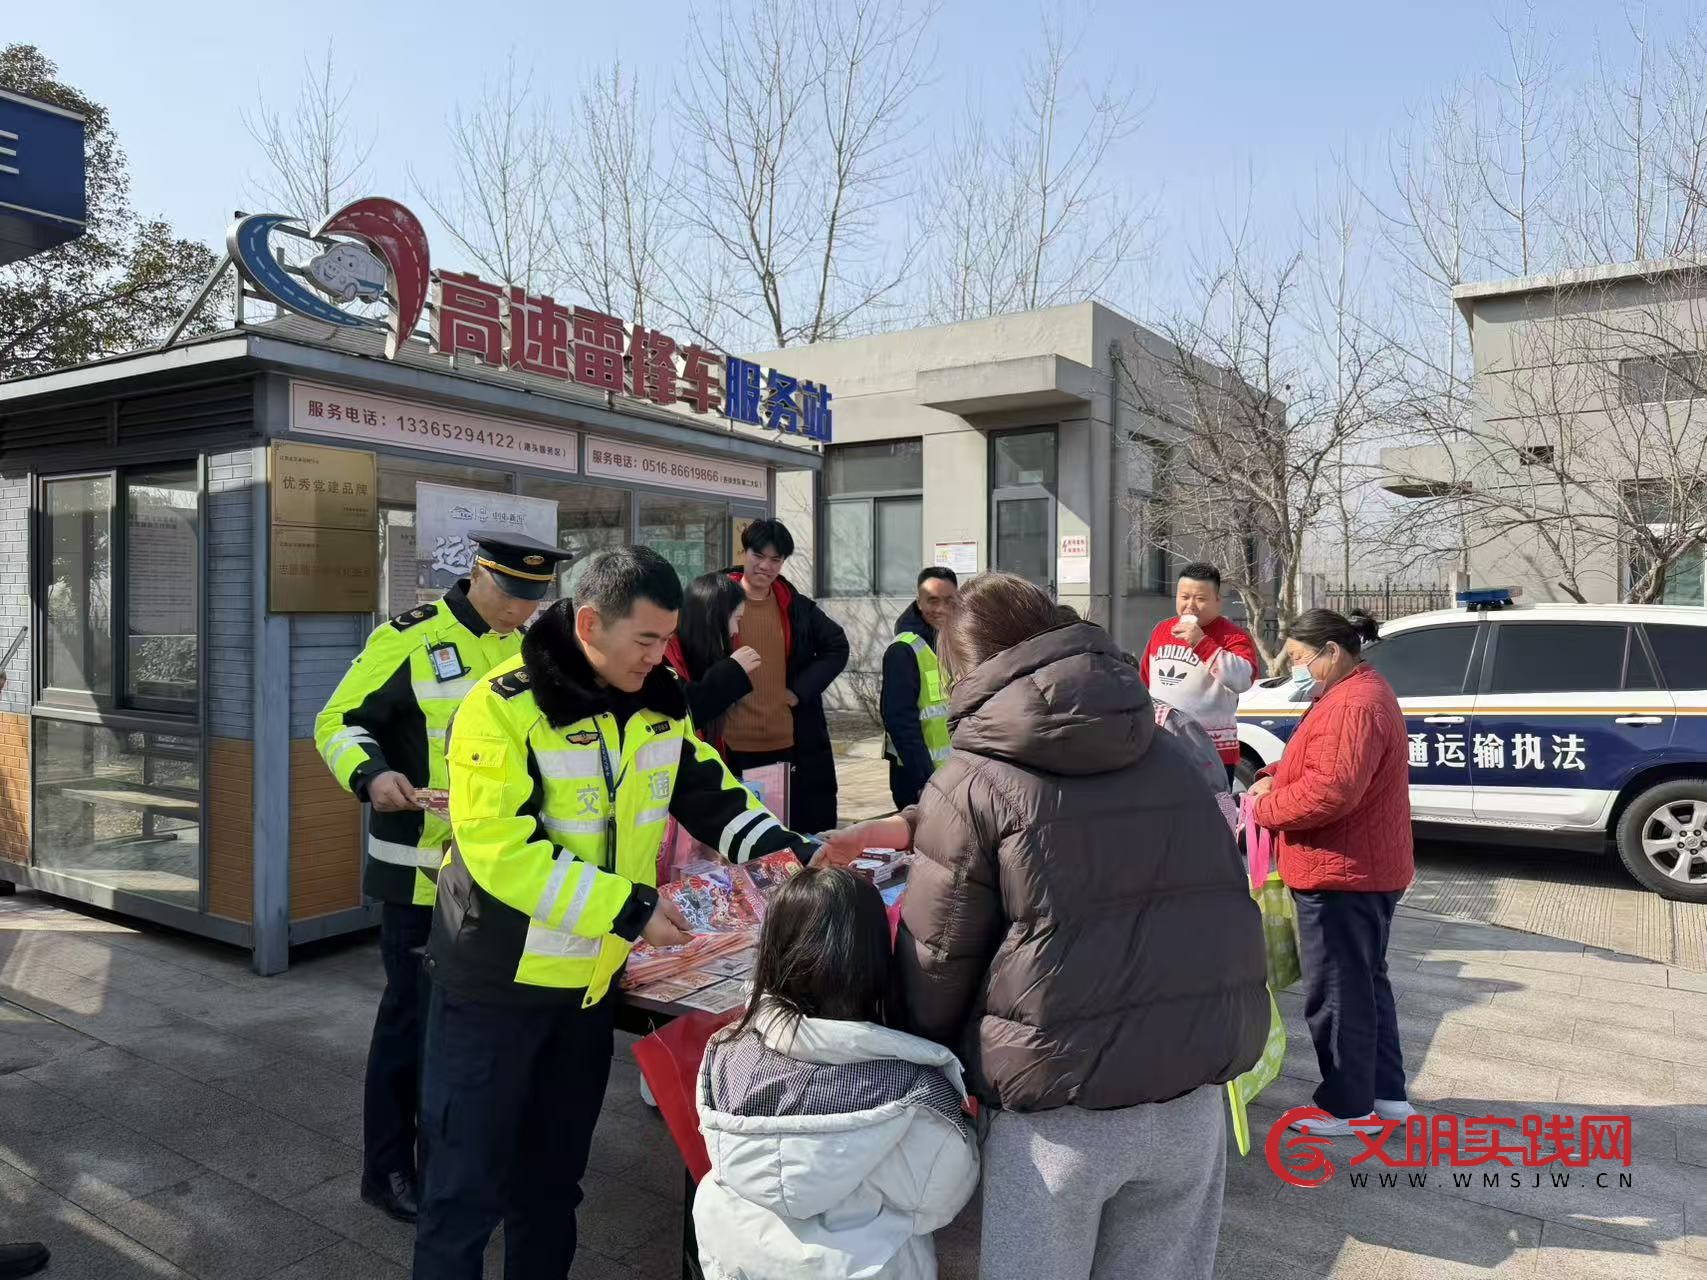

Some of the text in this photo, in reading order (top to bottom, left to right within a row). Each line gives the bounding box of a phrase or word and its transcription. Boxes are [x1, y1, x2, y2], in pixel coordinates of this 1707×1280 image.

[431, 268, 832, 442] 高速雷锋车服务站
[282, 475, 369, 496] 优秀党建品牌
